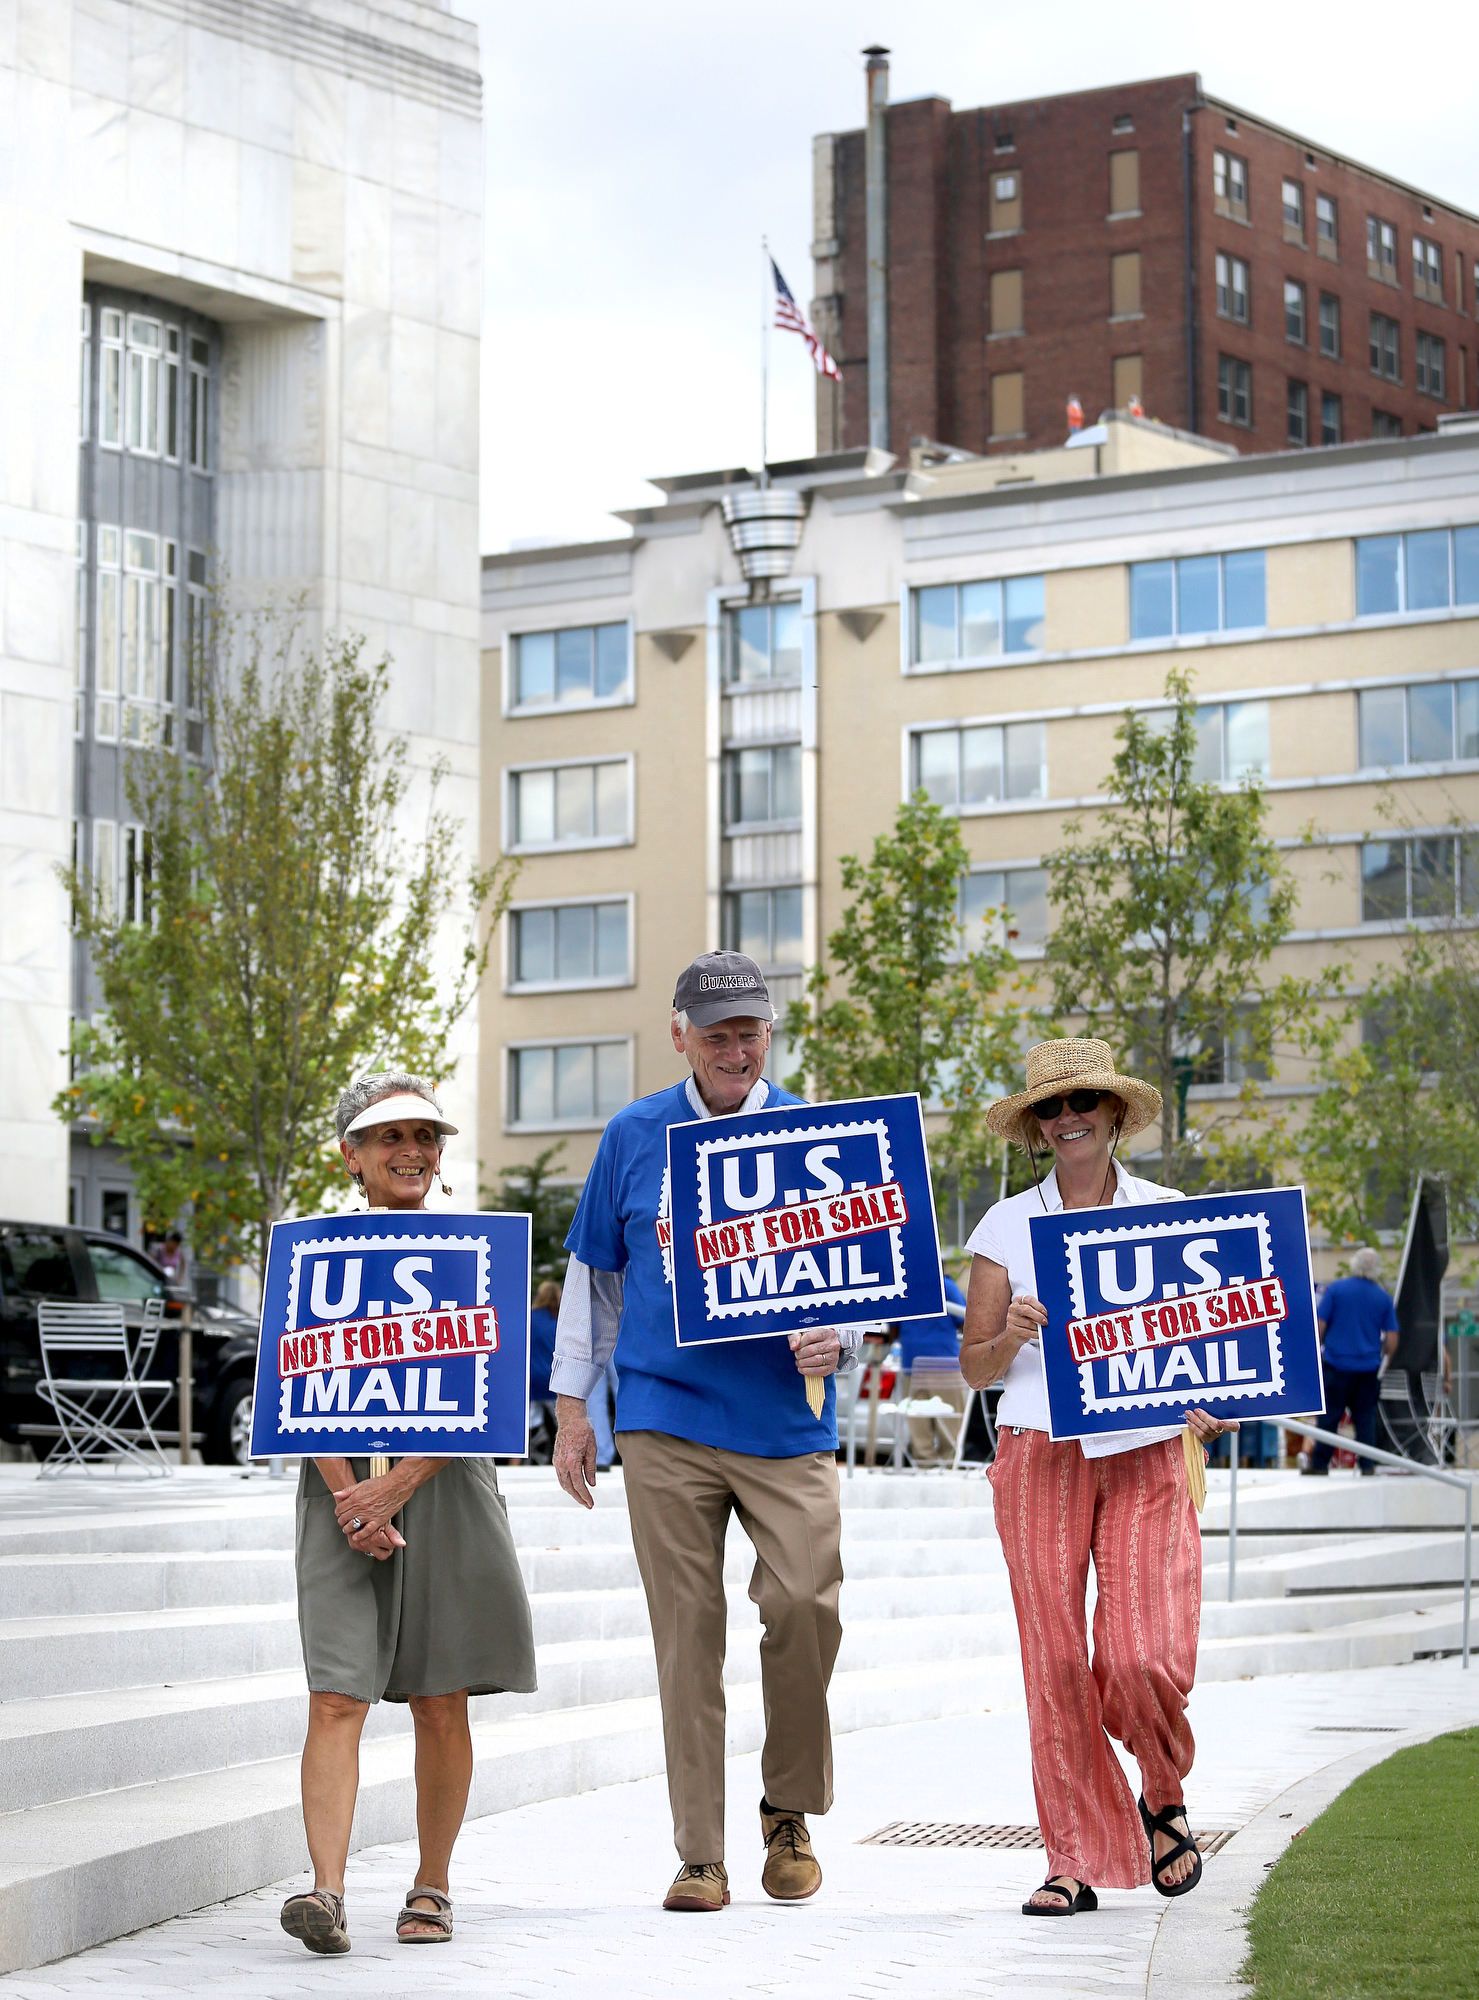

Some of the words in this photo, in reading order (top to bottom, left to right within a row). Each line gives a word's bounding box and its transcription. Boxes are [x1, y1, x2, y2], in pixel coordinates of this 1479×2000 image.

[722, 1144, 868, 1212] U.S.
[699, 1221, 756, 1264] NOT
[763, 1207, 825, 1248] FOR
[828, 1188, 901, 1232] SALE
[309, 1255, 459, 1321] U.S.
[730, 1244, 880, 1299] MAIL
[1097, 1238, 1246, 1305] U.S.
[282, 1330, 335, 1373] NOT
[343, 1321, 405, 1361] FOR
[411, 1312, 493, 1353] SALE
[1072, 1313, 1134, 1358] NOT
[1141, 1302, 1202, 1342] FOR
[1206, 1283, 1281, 1327] SALE
[301, 1366, 459, 1413] MAIL
[1108, 1339, 1257, 1394] MAIL
